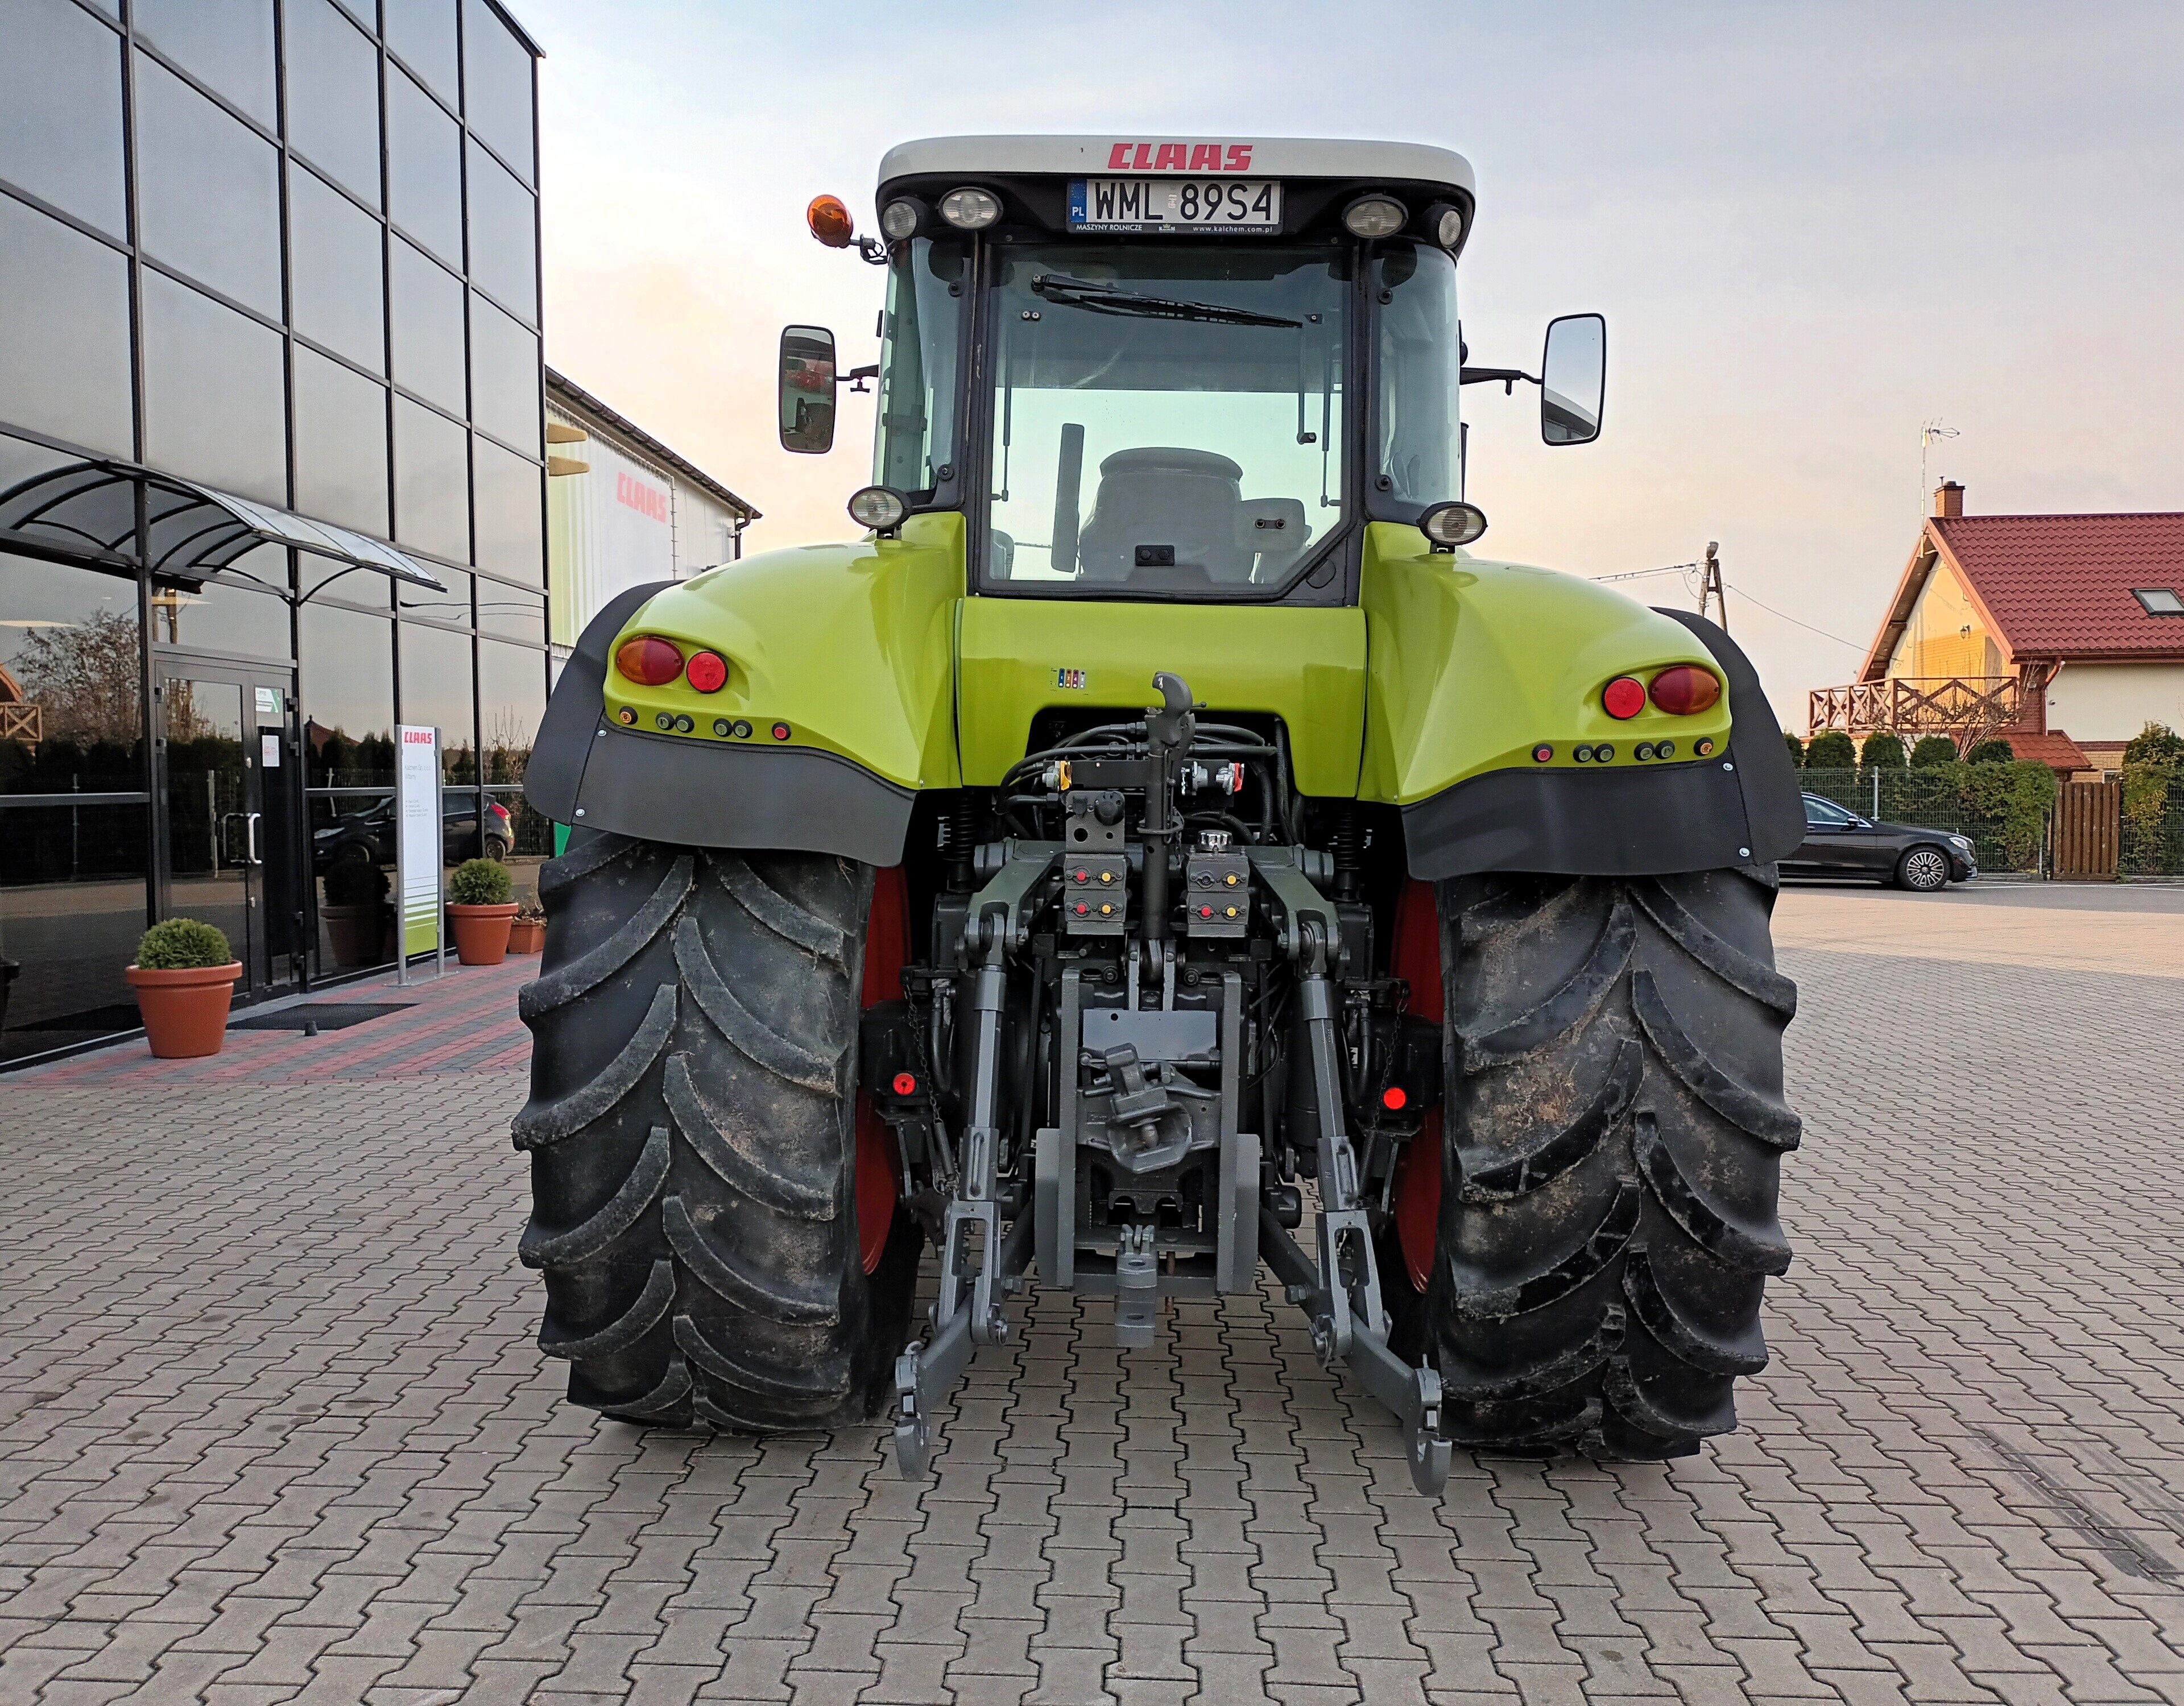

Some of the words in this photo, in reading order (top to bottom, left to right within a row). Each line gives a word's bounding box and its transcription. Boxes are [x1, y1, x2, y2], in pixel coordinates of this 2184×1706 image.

[1108, 143, 1254, 171] CLAAS
[1072, 206, 1085, 217] PL
[1095, 183, 1163, 220] WML
[1180, 183, 1272, 221] 89S4
[617, 471, 667, 523] CLAAS
[404, 731, 432, 744] CLAAS
